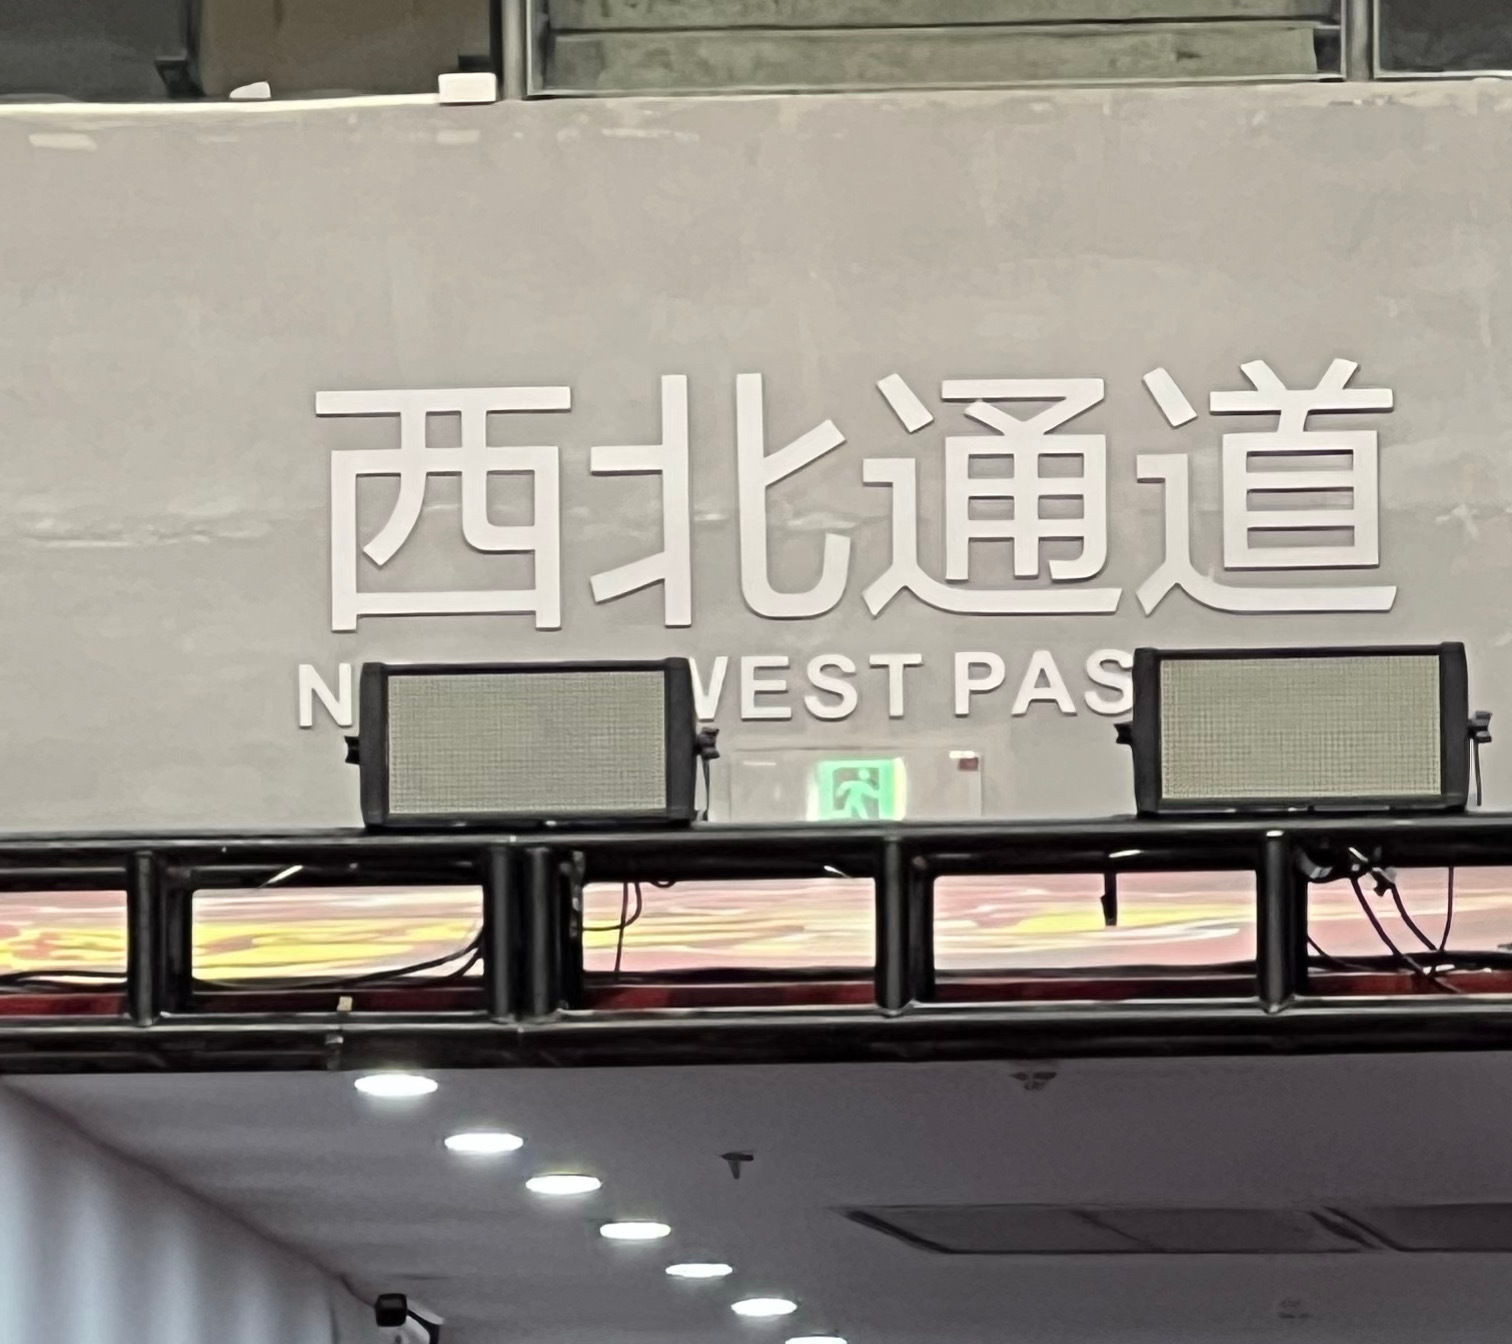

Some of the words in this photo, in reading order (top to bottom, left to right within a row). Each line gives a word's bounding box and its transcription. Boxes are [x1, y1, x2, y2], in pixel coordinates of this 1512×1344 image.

[315, 358, 1396, 632] 西北通道
[953, 648, 1134, 718] PAS
